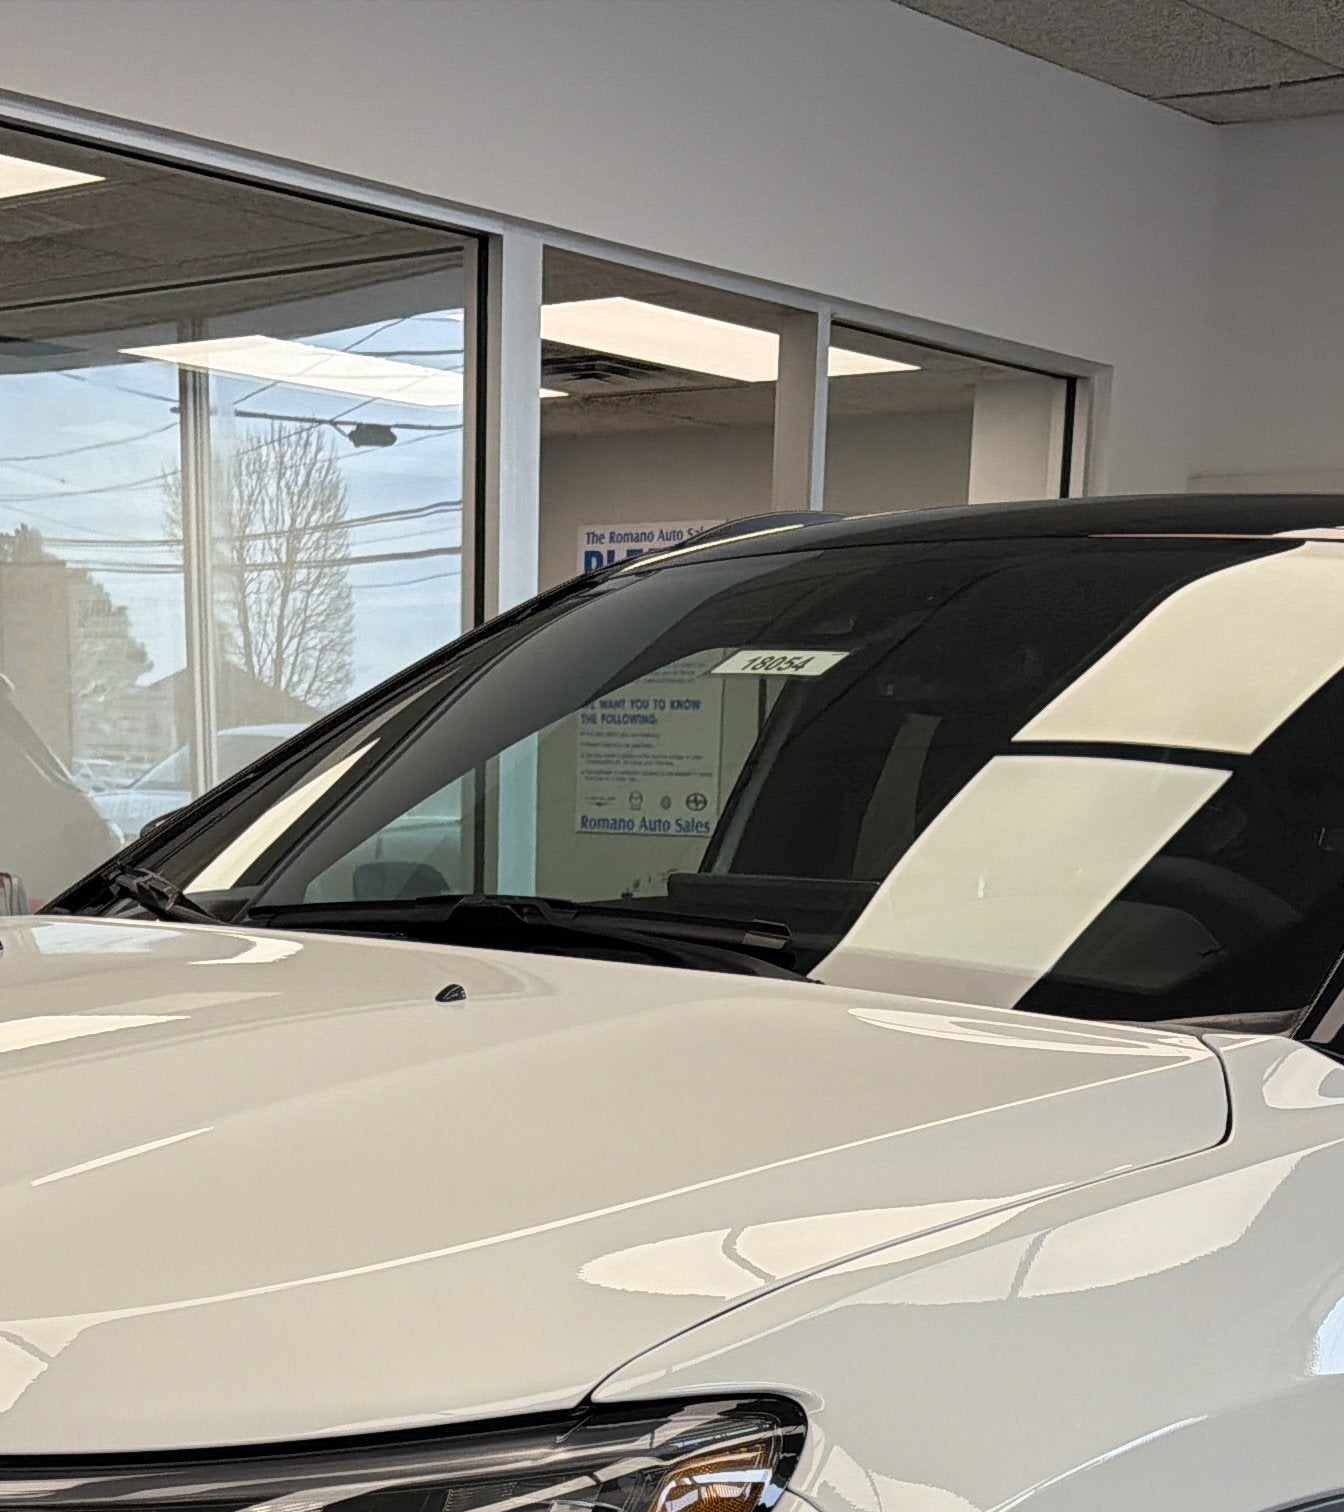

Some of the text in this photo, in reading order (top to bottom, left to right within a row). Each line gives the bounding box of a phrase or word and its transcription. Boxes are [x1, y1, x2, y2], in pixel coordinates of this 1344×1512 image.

[585, 531, 605, 545] The
[609, 531, 654, 543] Romano
[658, 529, 683, 542] Auto
[741, 656, 815, 671] 18054
[599, 699, 626, 711] WANT
[630, 699, 649, 710] YOU
[653, 699, 666, 710] TO
[670, 699, 702, 711] KNOW
[581, 714, 597, 724] THE
[580, 815, 711, 834] Romano Auto Sales
